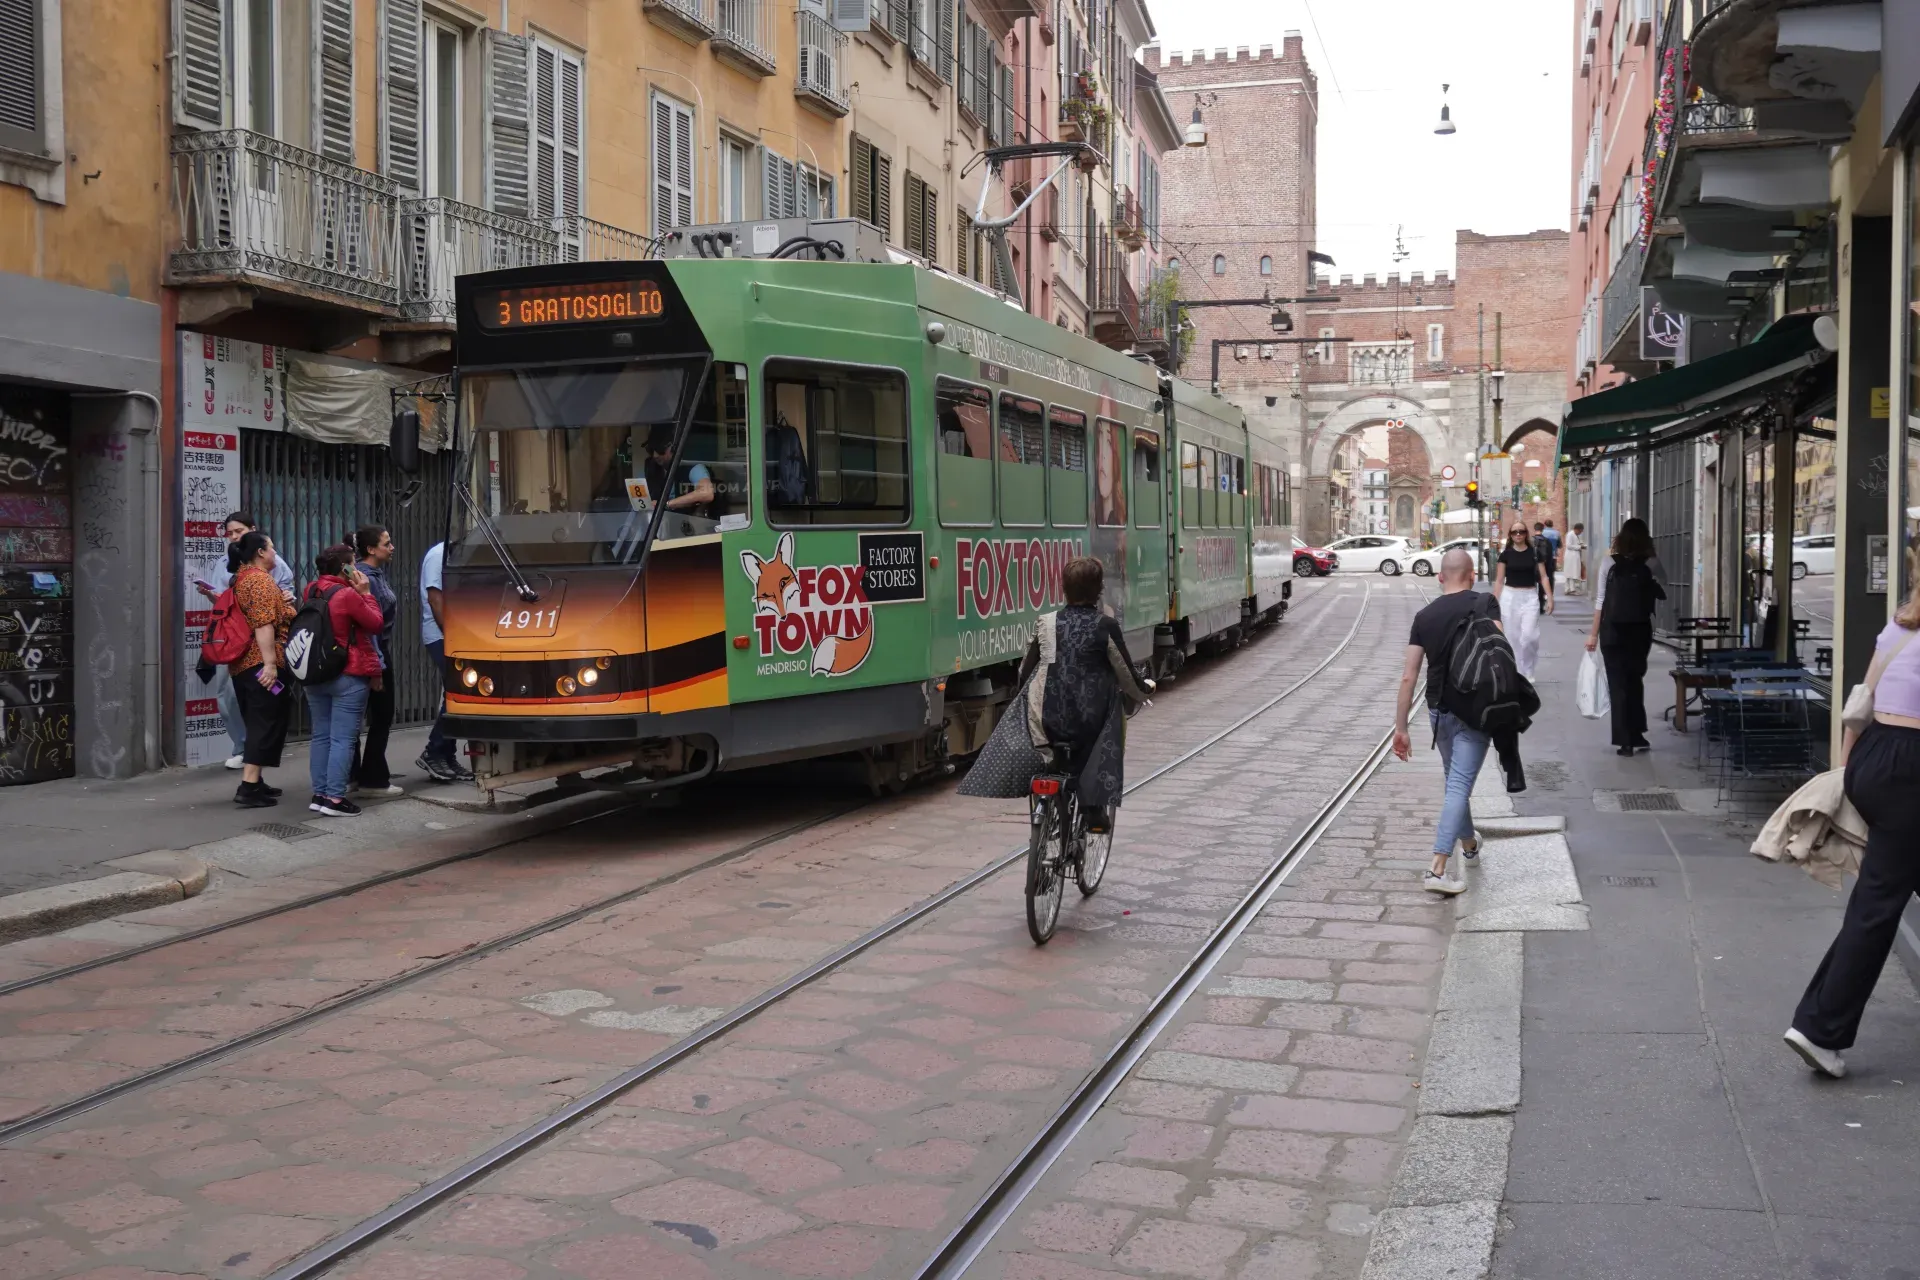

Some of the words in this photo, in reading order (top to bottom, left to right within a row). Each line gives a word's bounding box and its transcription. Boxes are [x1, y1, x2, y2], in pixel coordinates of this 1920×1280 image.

[499, 302, 511, 325] 3
[520, 290, 663, 323] GRATOSOGLIO
[972, 328, 990, 360] 160
[184, 451, 225, 465] 吉祥集团
[634, 486, 642, 498] 8
[639, 499, 646, 509] 3
[868, 547, 916, 566] FACTORY
[797, 565, 869, 608] FOX
[869, 568, 917, 588] STORES
[956, 537, 1083, 620] FOXTOW
[499, 610, 557, 629] 4911
[755, 606, 870, 655] TOWN
[285, 628, 310, 667] NIKE
[957, 630, 987, 661] YOUR
[989, 622, 1031, 657] FASHION
[756, 659, 808, 676] MENDRISIO
